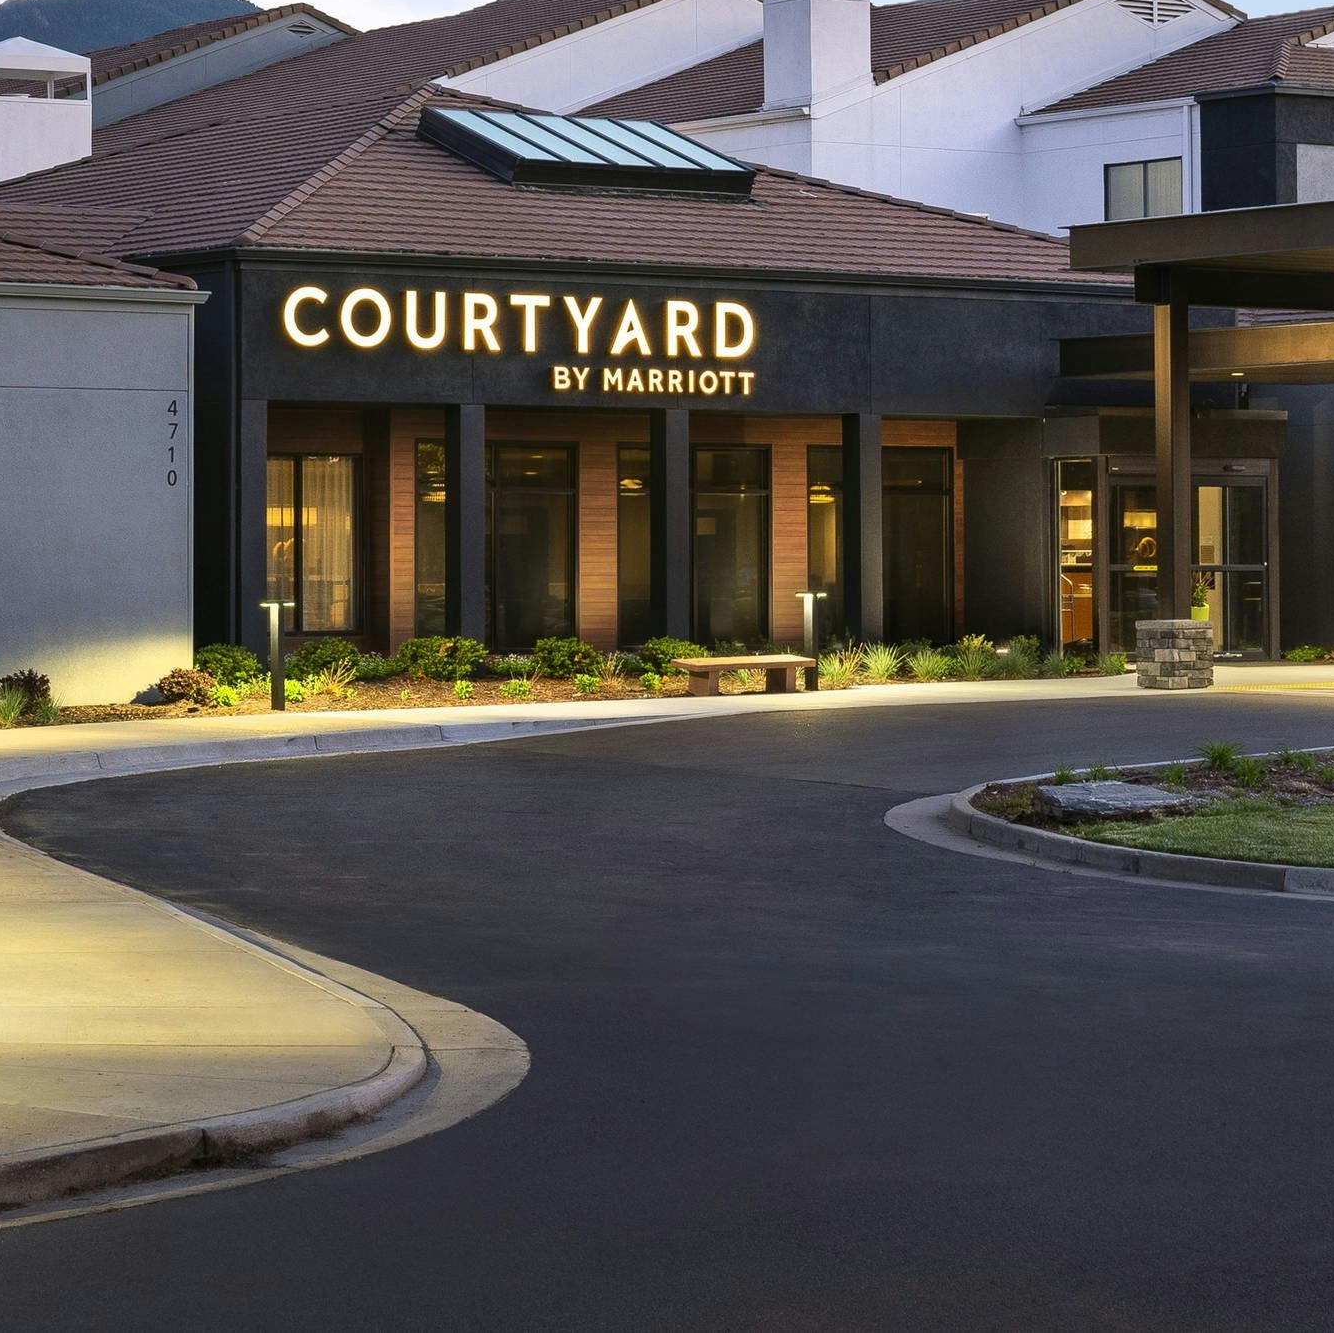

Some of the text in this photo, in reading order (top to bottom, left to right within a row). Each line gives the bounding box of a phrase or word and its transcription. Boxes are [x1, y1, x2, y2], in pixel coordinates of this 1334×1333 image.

[283, 286, 756, 358] COURTYARD
[553, 366, 755, 396] BY MARRIOTT
[166, 399, 179, 487] 4710
